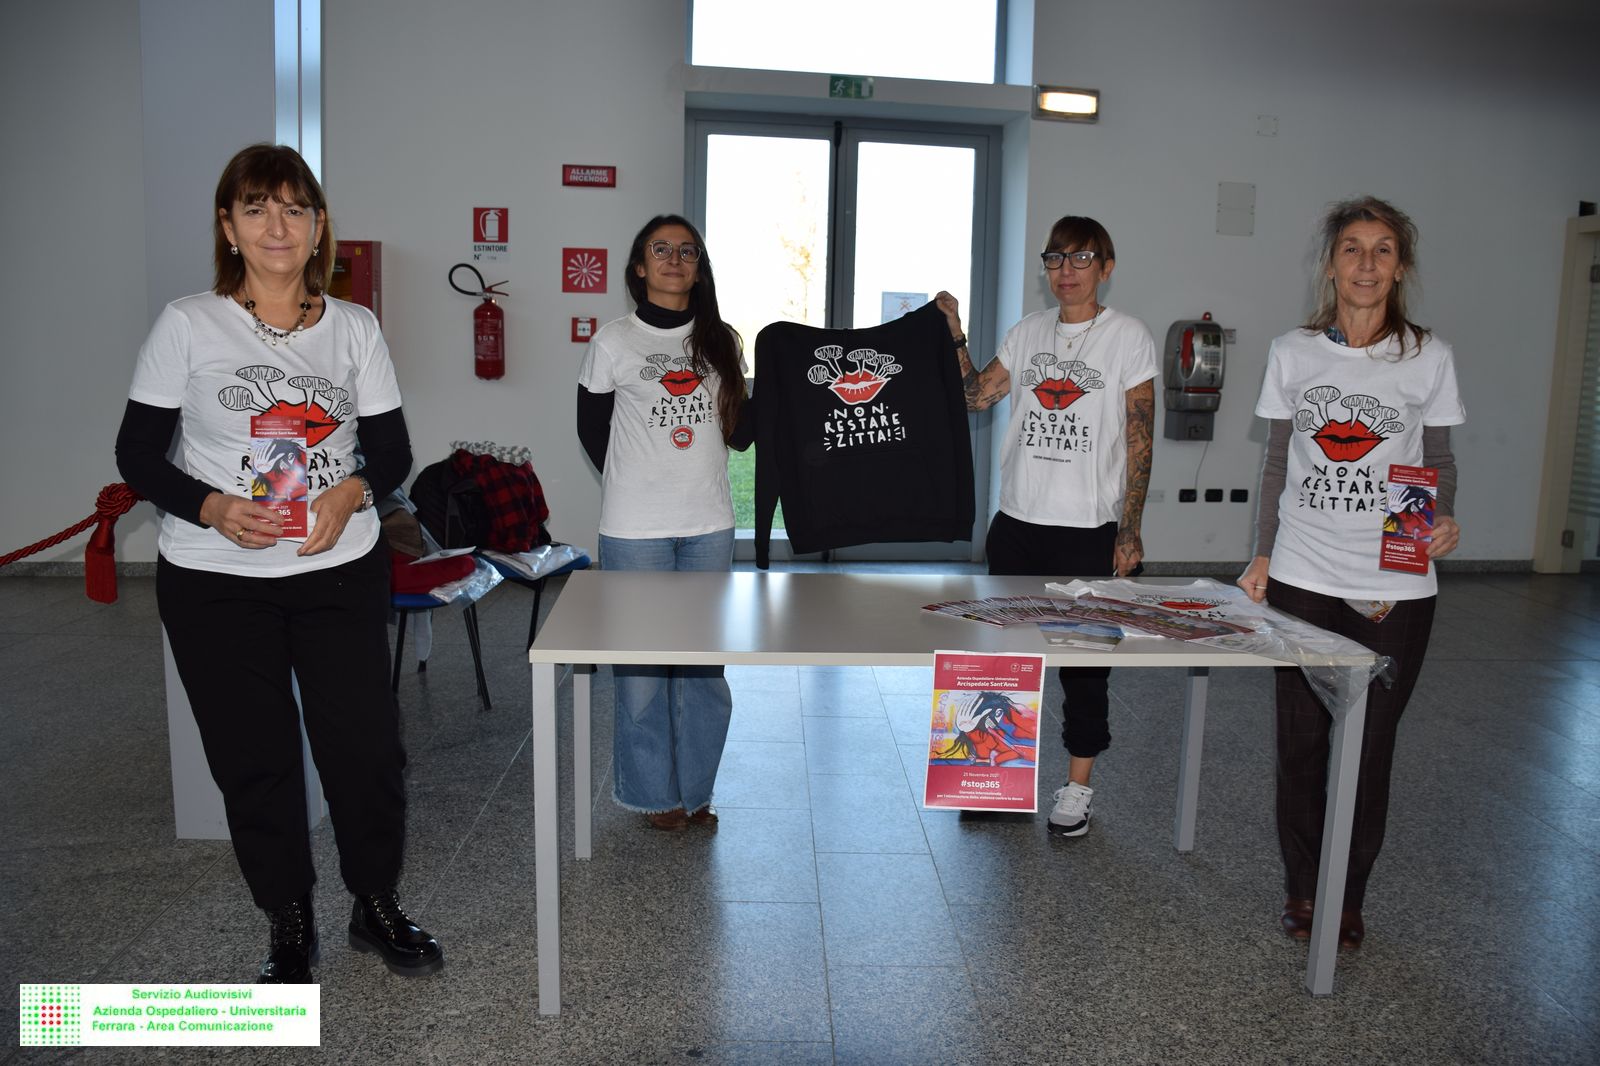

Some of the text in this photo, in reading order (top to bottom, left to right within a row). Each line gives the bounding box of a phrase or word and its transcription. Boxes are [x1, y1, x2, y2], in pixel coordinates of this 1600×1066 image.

[570, 168, 608, 176] ALLARME
[570, 175, 608, 183] INCENDIO
[661, 393, 702, 405] NON
[652, 401, 713, 416] RESTARE
[834, 402, 884, 419] NON
[824, 413, 900, 434] RESTARE
[1029, 410, 1076, 424] NON
[1314, 464, 1371, 478] NON
[1302, 476, 1387, 495] RESTARE
[1385, 543, 1416, 553] #stop365
[961, 780, 1001, 790] #stop365
